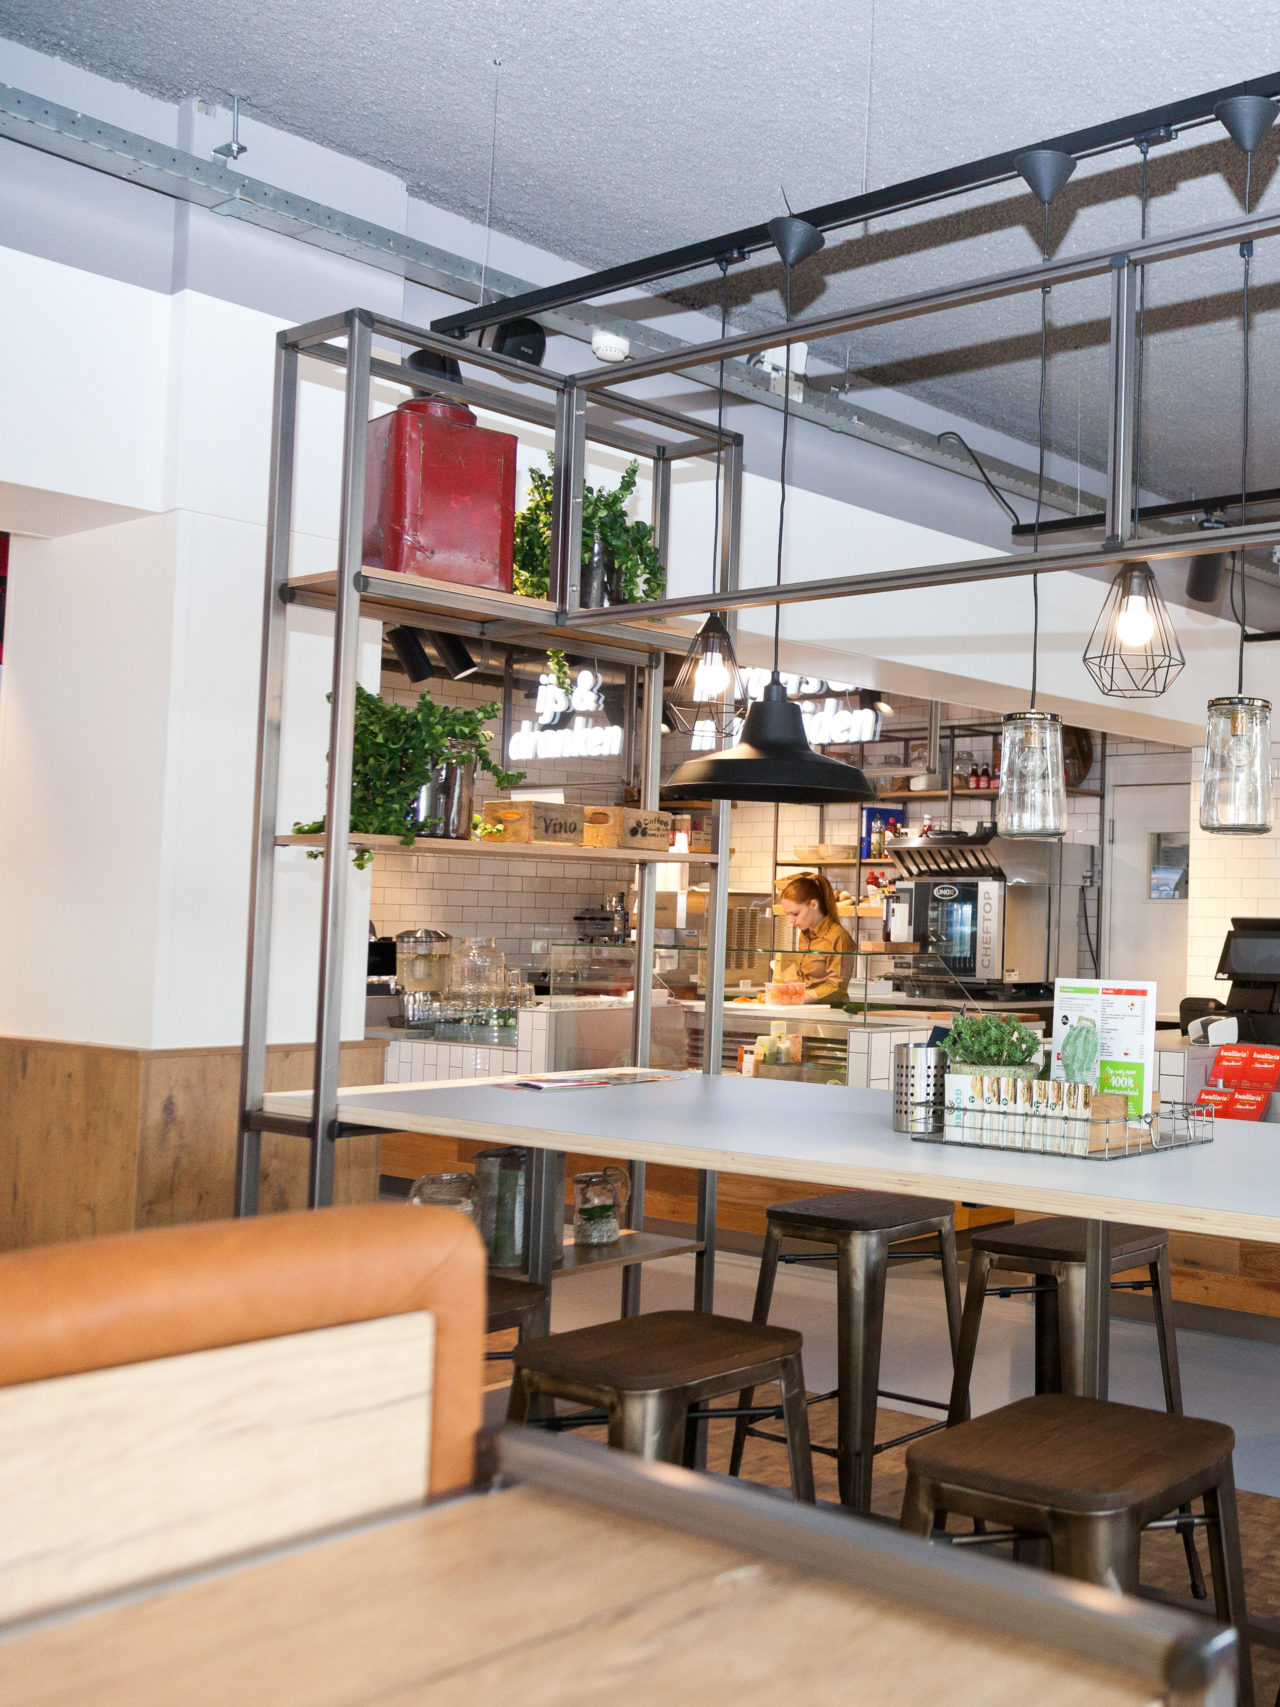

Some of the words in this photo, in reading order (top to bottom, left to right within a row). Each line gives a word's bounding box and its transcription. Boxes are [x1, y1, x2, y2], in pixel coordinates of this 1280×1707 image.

[571, 670, 605, 712] &
[508, 716, 624, 761] dranken
[541, 816, 578, 835] Vino
[643, 816, 669, 828] Coffee
[981, 890, 993, 970] CHEFTOP
[1110, 1075, 1134, 1089] 100%
